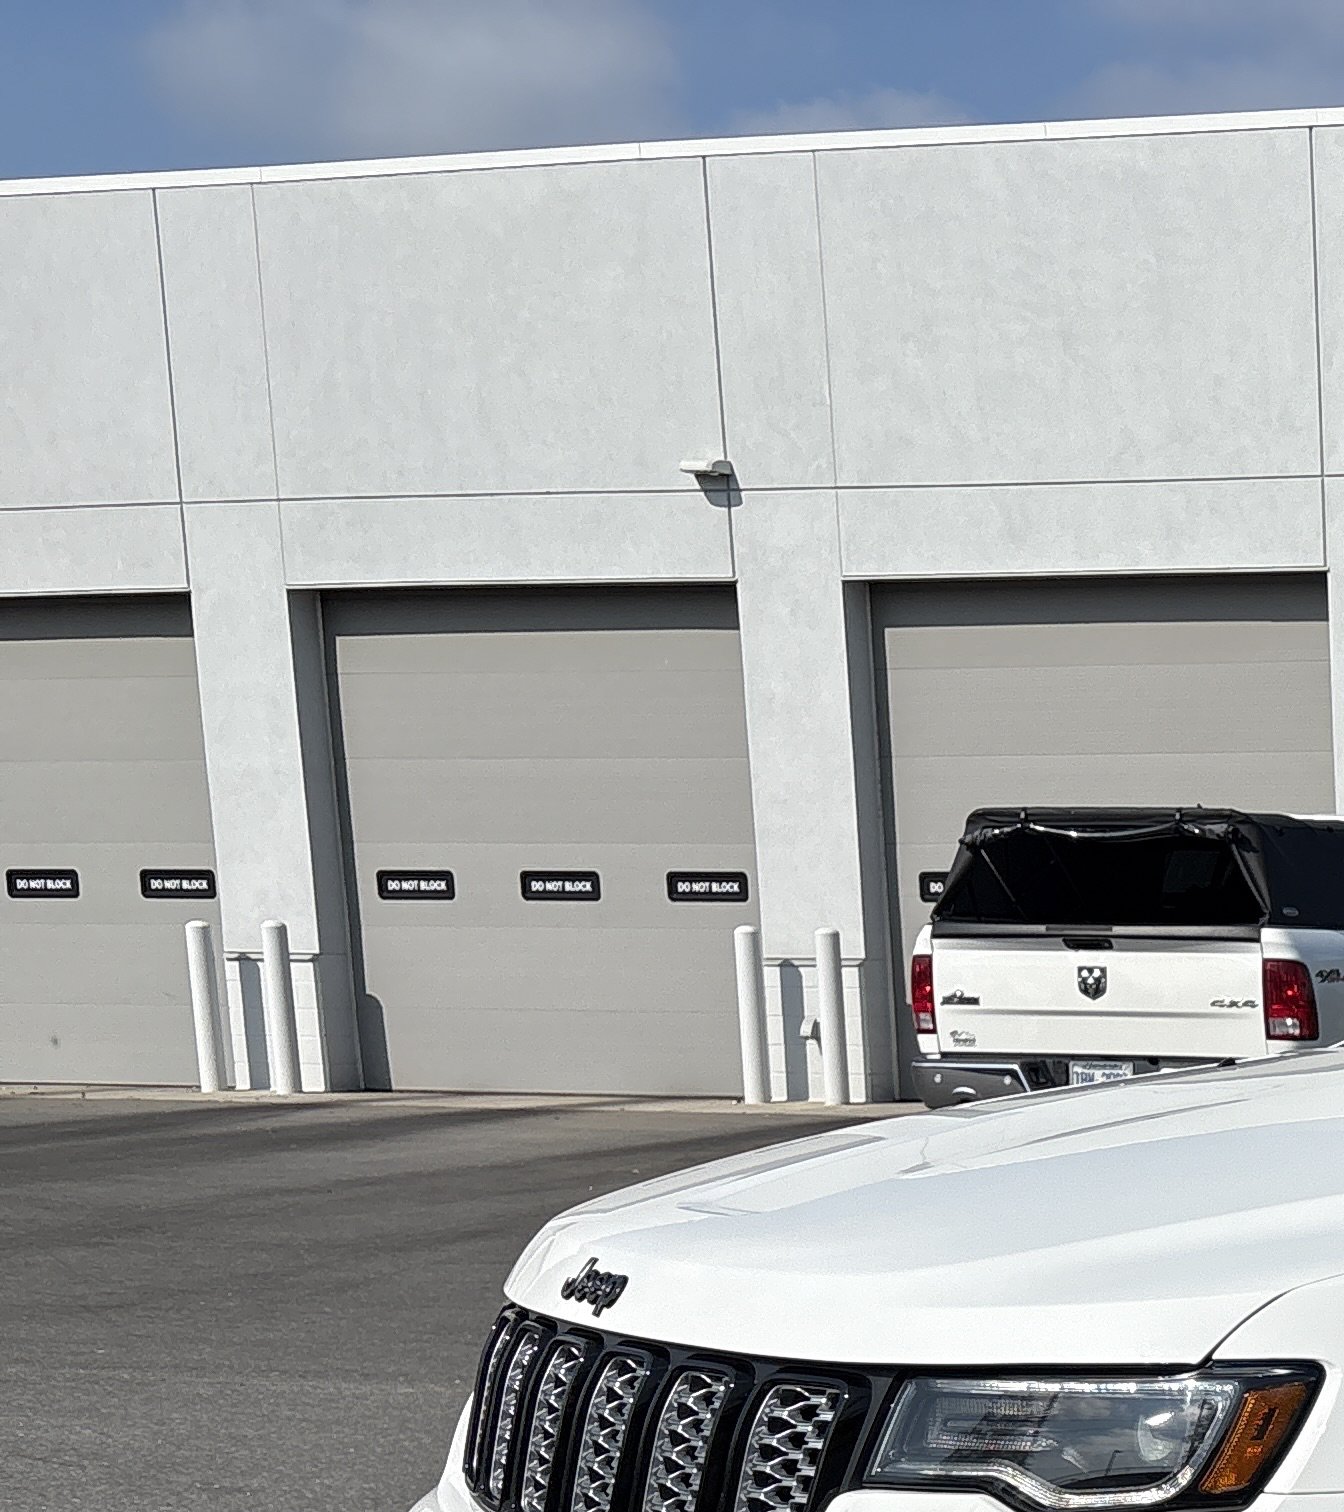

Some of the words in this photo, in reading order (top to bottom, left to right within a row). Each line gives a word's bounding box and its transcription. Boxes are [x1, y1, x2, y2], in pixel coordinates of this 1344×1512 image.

[16, 879, 28, 889] DO
[29, 879, 45, 889] NOT
[46, 879, 72, 889] BLOCK
[150, 879, 163, 889] DO
[164, 879, 180, 889] NOT
[181, 879, 209, 889] BLOCK
[387, 880, 400, 890] DO
[401, 880, 418, 890] NOT
[420, 880, 447, 890] BLOCK
[531, 881, 544, 891] DO
[545, 881, 563, 891] NOT
[564, 881, 592, 891] BLOCK
[677, 882, 690, 892] DO
[691, 882, 710, 892] NOT
[711, 882, 740, 892] BLOCK
[929, 881, 944, 893] DO
[561, 1257, 629, 1318] Jeep
